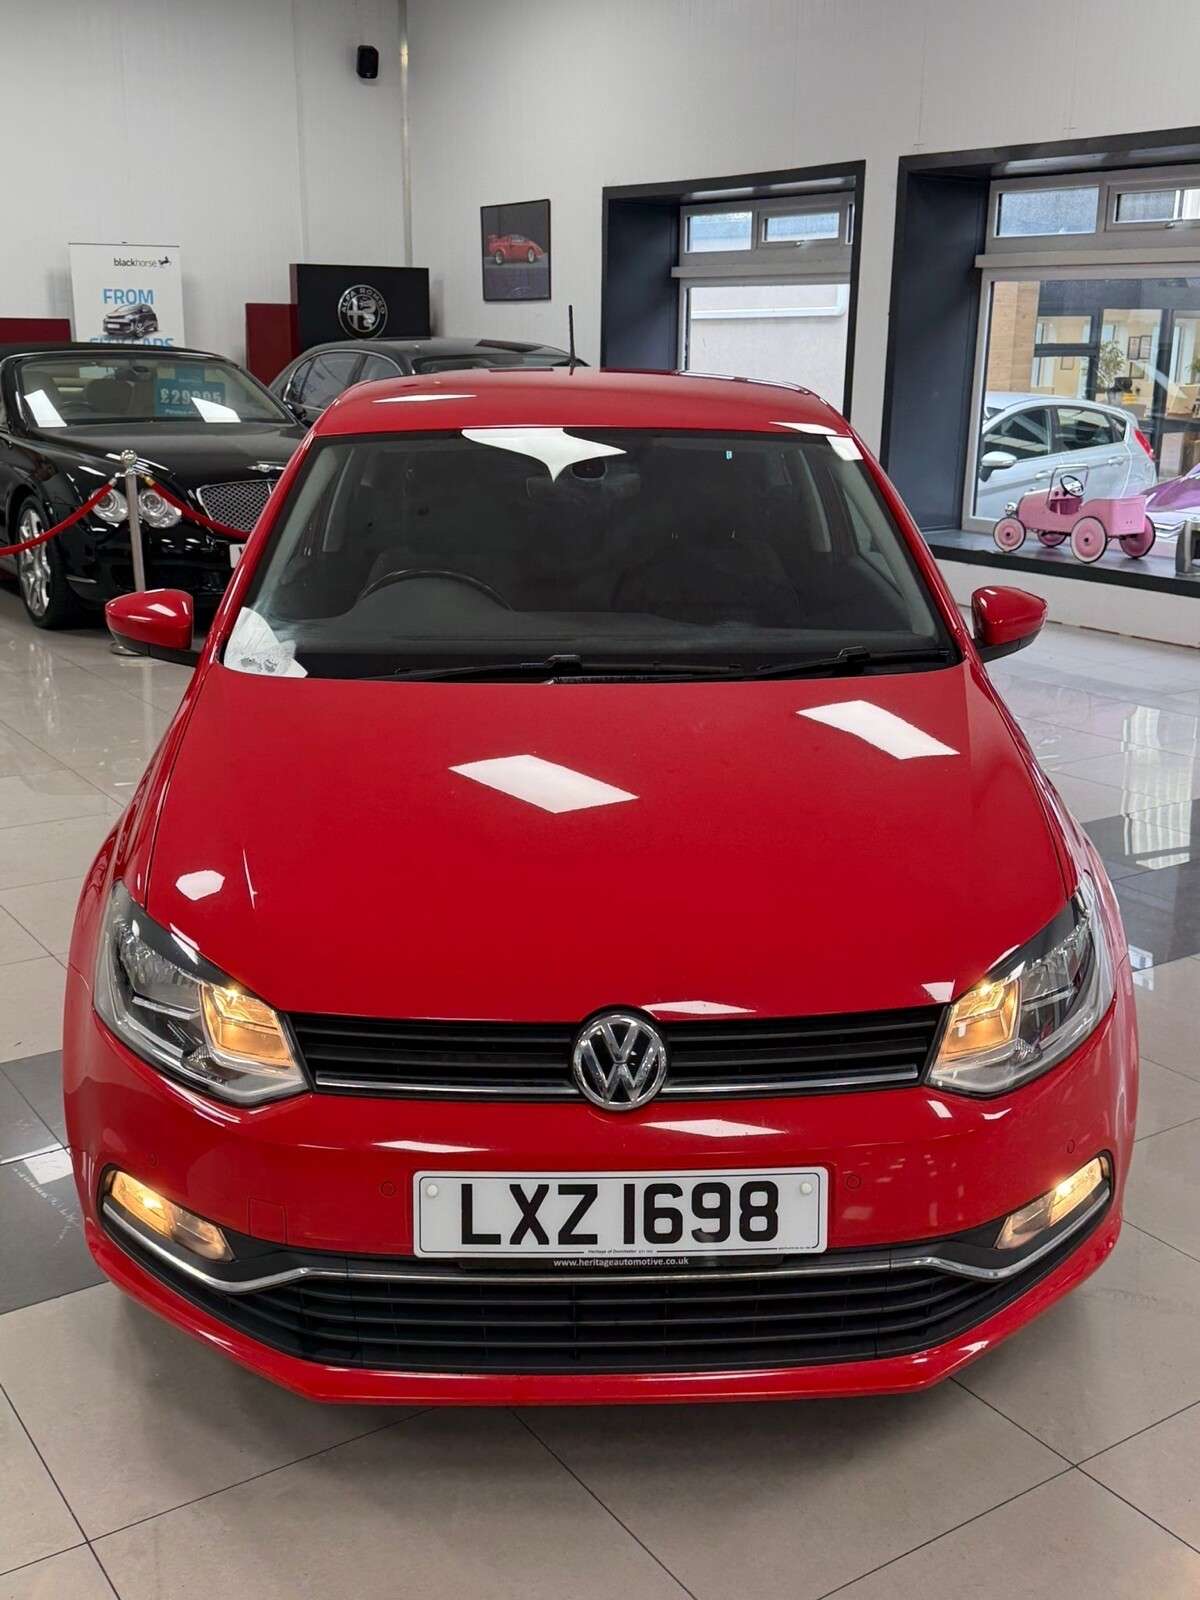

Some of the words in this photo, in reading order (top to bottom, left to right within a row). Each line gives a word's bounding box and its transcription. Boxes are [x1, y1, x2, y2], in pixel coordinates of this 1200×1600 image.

[113, 257, 157, 267] blackhorse
[102, 288, 154, 304] FROM
[341, 290, 357, 313] ALFA
[359, 287, 385, 314] ROMEO
[461, 1183, 598, 1245] LXZ
[623, 1180, 779, 1245] 1698
[553, 1256, 689, 1267] www.heritageautomotive.co.uk
